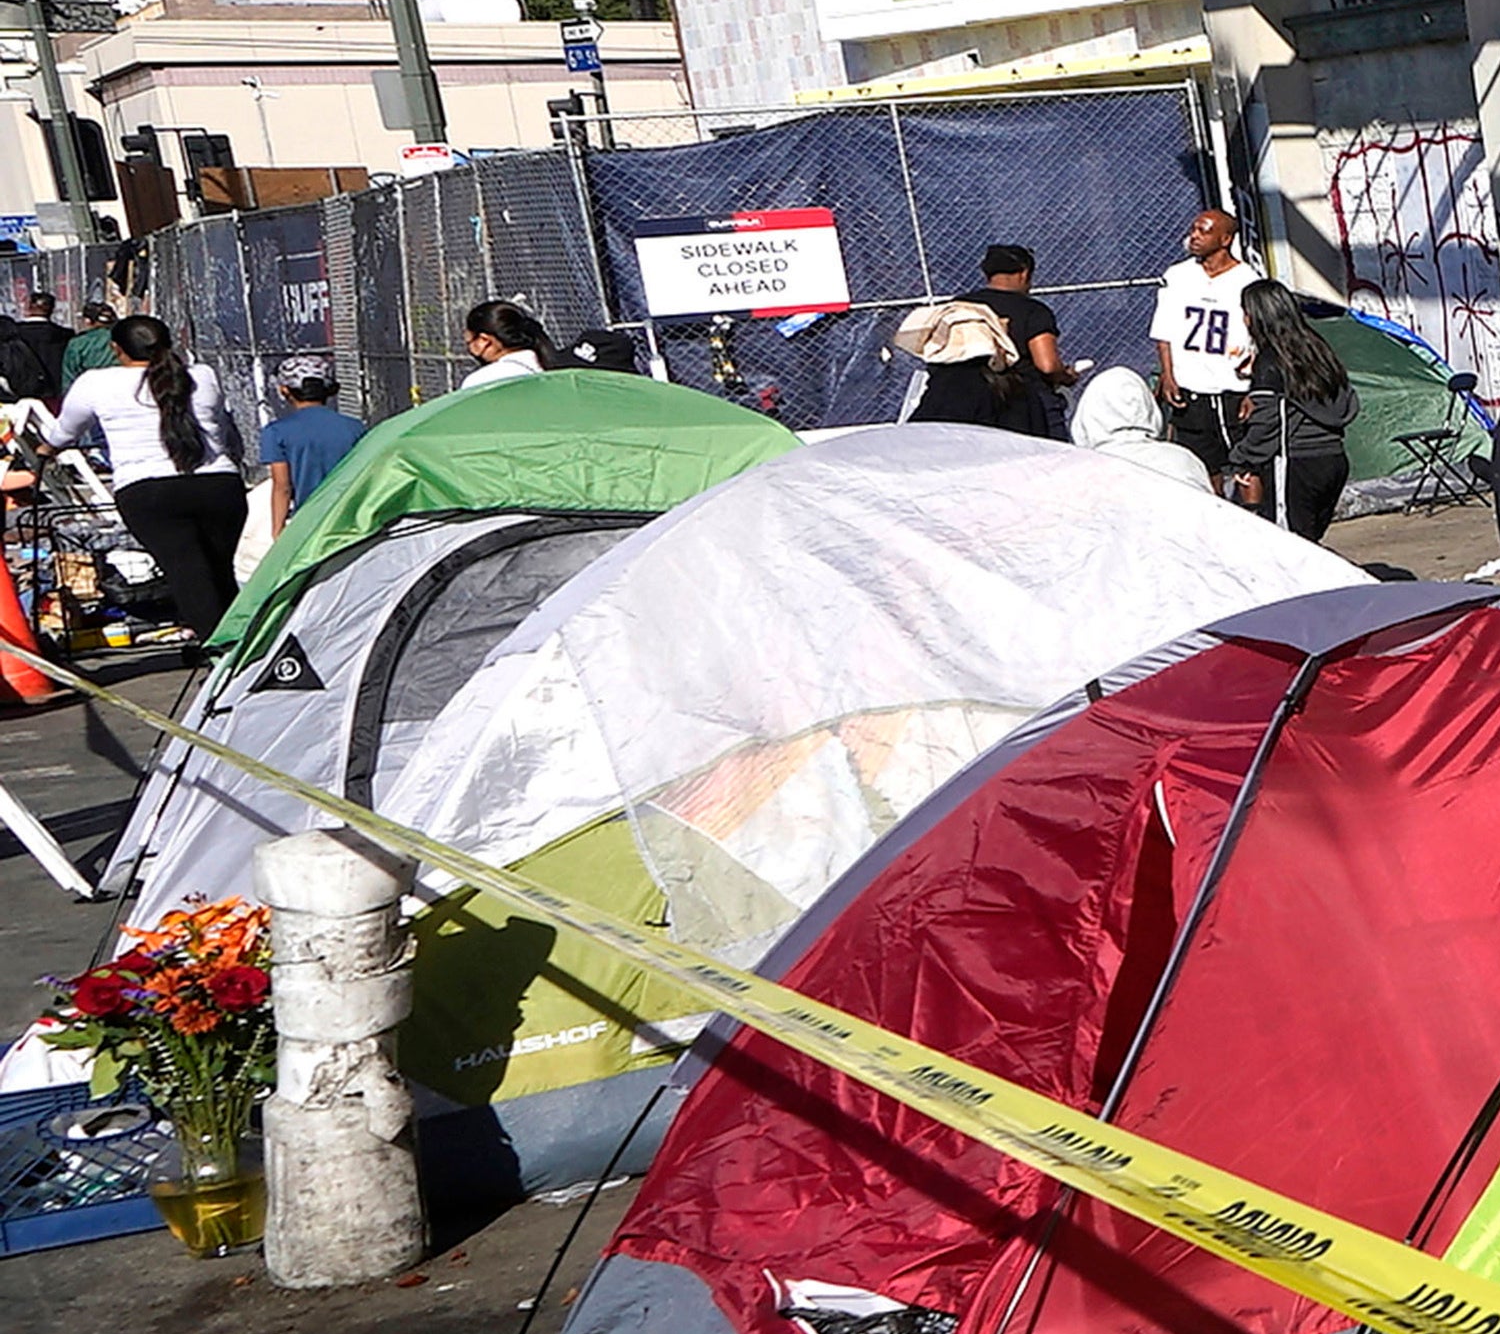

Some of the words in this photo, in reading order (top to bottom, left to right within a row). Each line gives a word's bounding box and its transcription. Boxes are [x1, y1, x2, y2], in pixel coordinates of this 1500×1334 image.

[681, 238, 799, 260] SIDEWALK
[698, 258, 788, 278] CLOSED
[708, 278, 786, 297] AHEAD
[1183, 306, 1229, 355] 28
[454, 1020, 608, 1071] HAUSHOF
